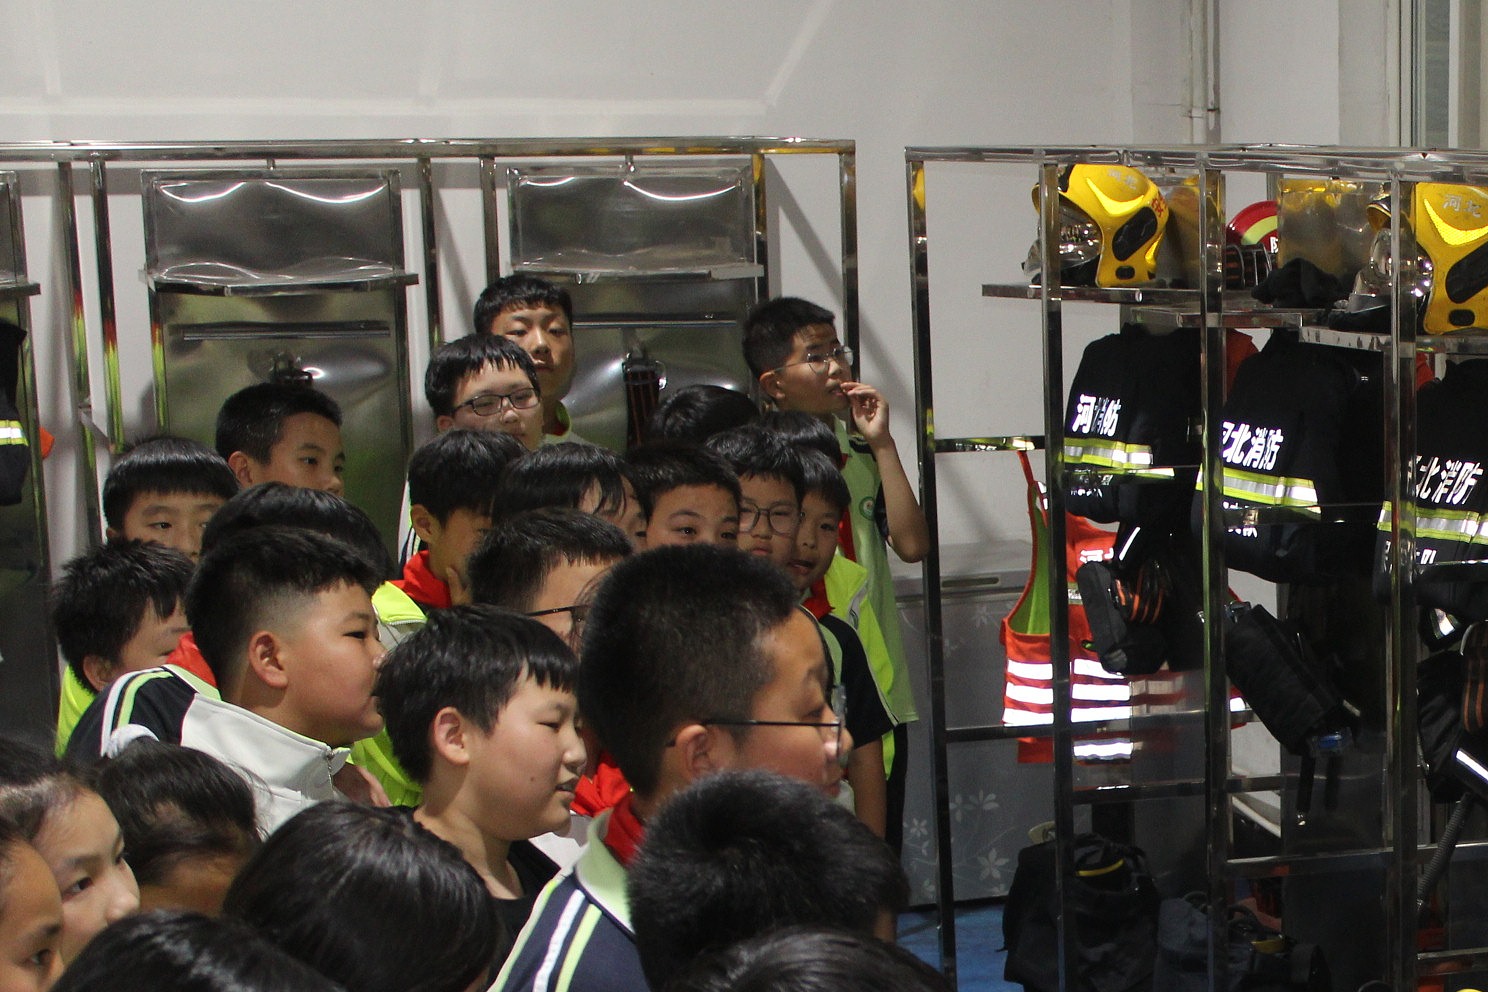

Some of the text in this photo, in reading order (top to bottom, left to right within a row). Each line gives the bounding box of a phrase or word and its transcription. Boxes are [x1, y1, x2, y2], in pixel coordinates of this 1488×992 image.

[1442, 194, 1482, 218] 河北
[1415, 455, 1484, 505] 北消防
